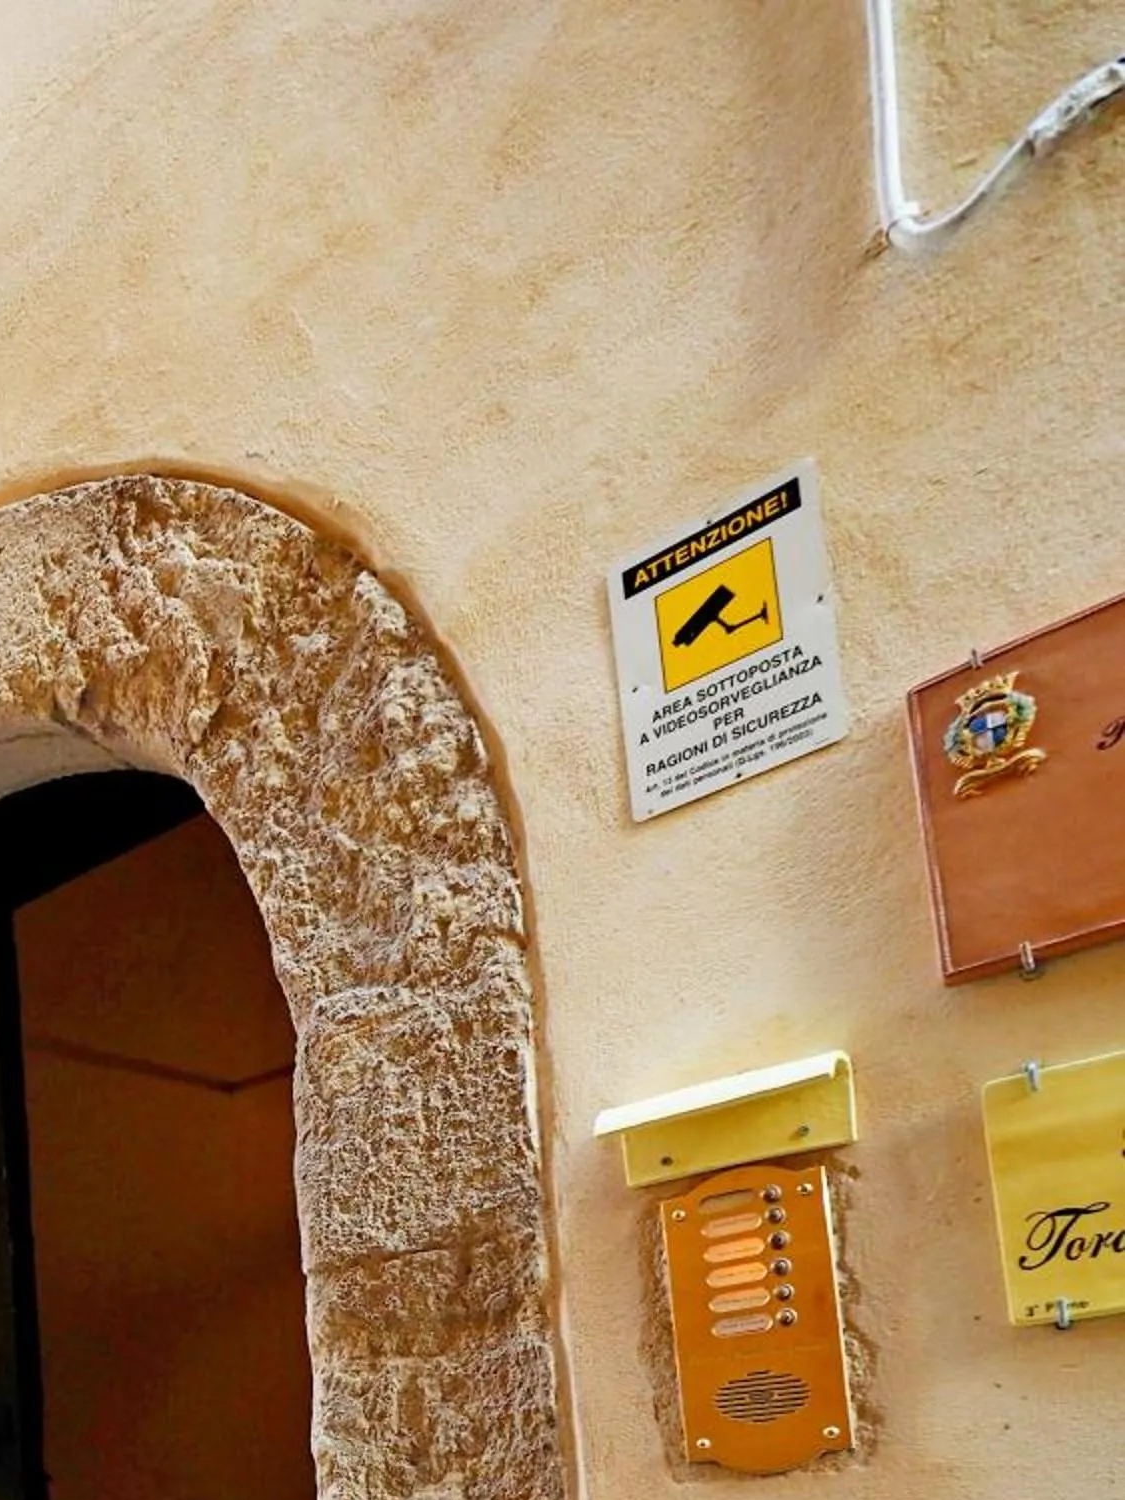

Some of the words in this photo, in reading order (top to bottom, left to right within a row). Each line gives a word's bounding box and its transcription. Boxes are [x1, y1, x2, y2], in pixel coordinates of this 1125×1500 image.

[634, 491, 788, 589] ATTENZIONE!
[640, 733, 650, 745] A
[653, 655, 822, 739] VIDEOSORVEGLIANZA
[652, 696, 693, 723] AREA
[696, 645, 803, 702] SOTTOPOSTA
[713, 707, 744, 730] PER
[646, 741, 708, 776] RAGIONI
[712, 732, 728, 749] DI
[731, 692, 822, 740] SICUREZZA
